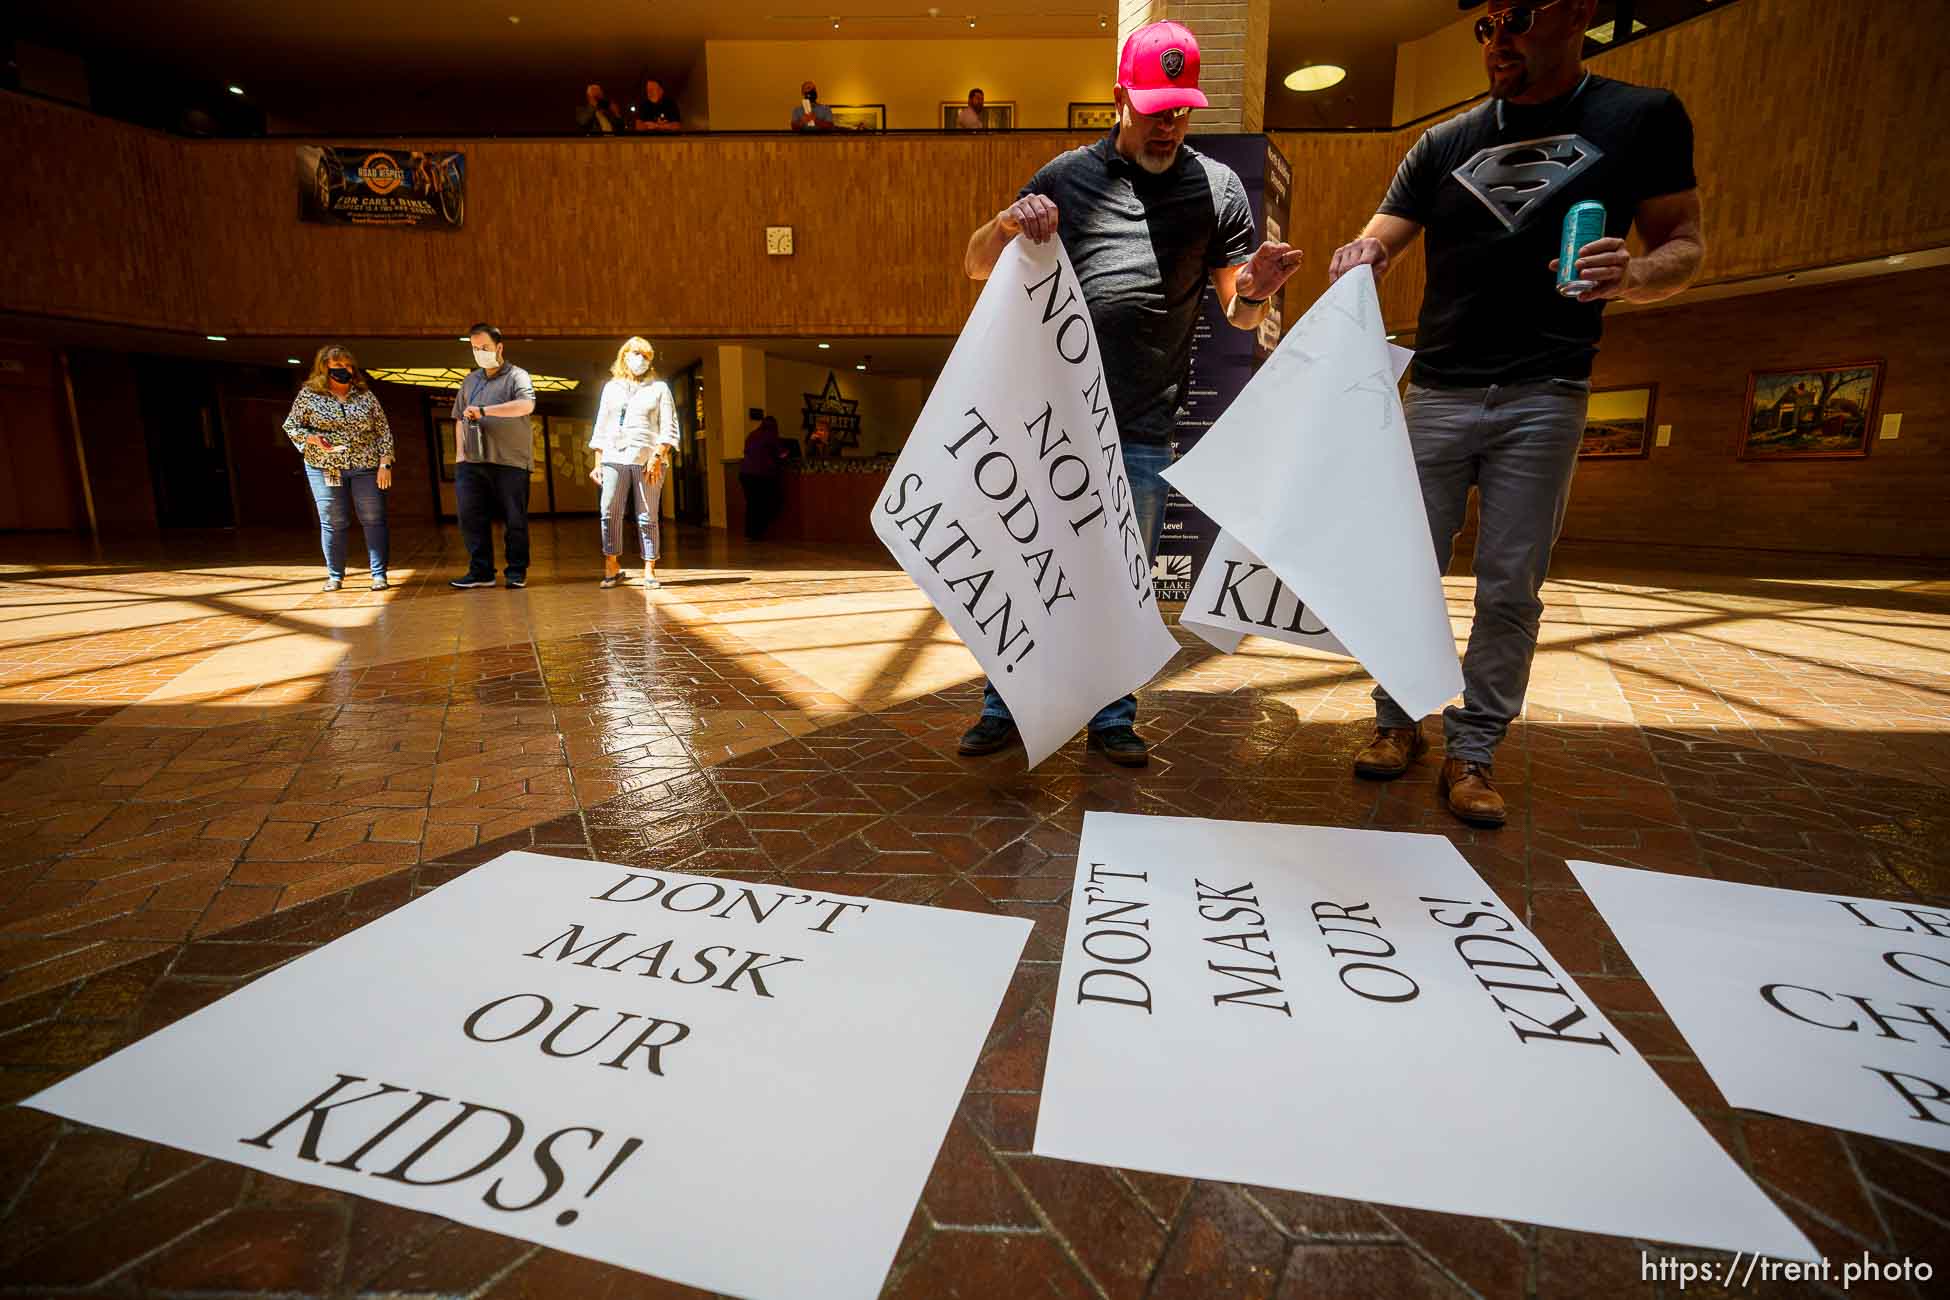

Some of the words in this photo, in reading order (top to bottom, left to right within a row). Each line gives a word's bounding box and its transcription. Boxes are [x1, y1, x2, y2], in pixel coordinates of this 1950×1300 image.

[1024, 260, 1090, 364] NO
[1082, 366, 1151, 609] MASKS!
[1024, 402, 1109, 536] NOT
[884, 472, 1036, 673] SATAN!
[943, 406, 1076, 616] TODAY
[1163, 521, 1183, 530] Level
[1163, 581, 1191, 589] LAKE
[522, 923, 804, 998] MASK
[590, 873, 868, 934] DON'T
[1077, 862, 1153, 1015] DON'T
[1194, 877, 1293, 1018] MASK
[1311, 900, 1421, 1004] OUR
[463, 993, 690, 1076] OUR
[1418, 896, 1621, 1056] KIDS!
[1759, 983, 1950, 1048] CH
[238, 1073, 644, 1227] KIDS!
